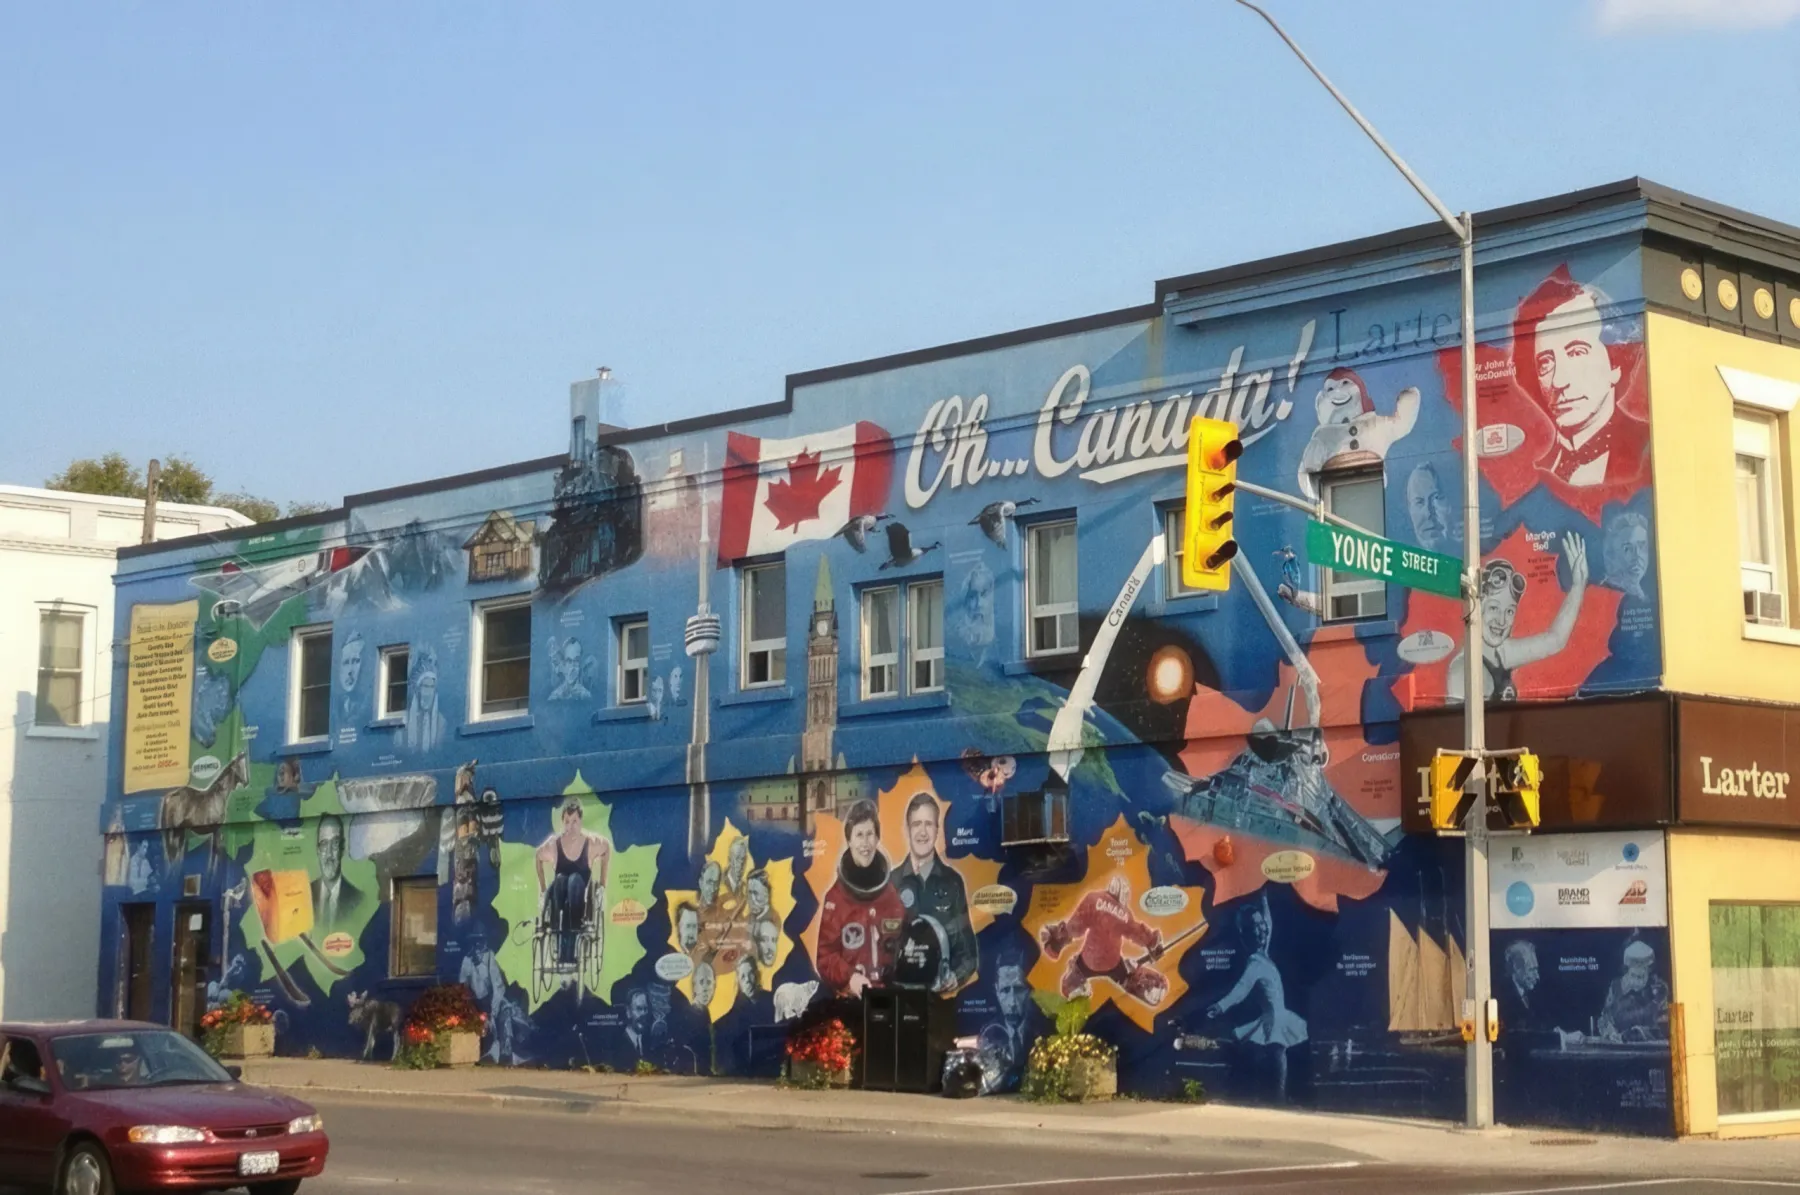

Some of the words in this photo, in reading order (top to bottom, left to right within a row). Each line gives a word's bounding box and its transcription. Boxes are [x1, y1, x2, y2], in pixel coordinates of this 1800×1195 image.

[1329, 308, 1462, 362] Larte
[1484, 360, 1505, 371] John
[1033, 319, 1316, 478] Canada!
[1331, 531, 1394, 576] YONGE
[1402, 551, 1439, 576] STREET
[1108, 575, 1141, 627] Canada
[1699, 755, 1791, 800] Larter
[1095, 898, 1129, 925] CANADA
